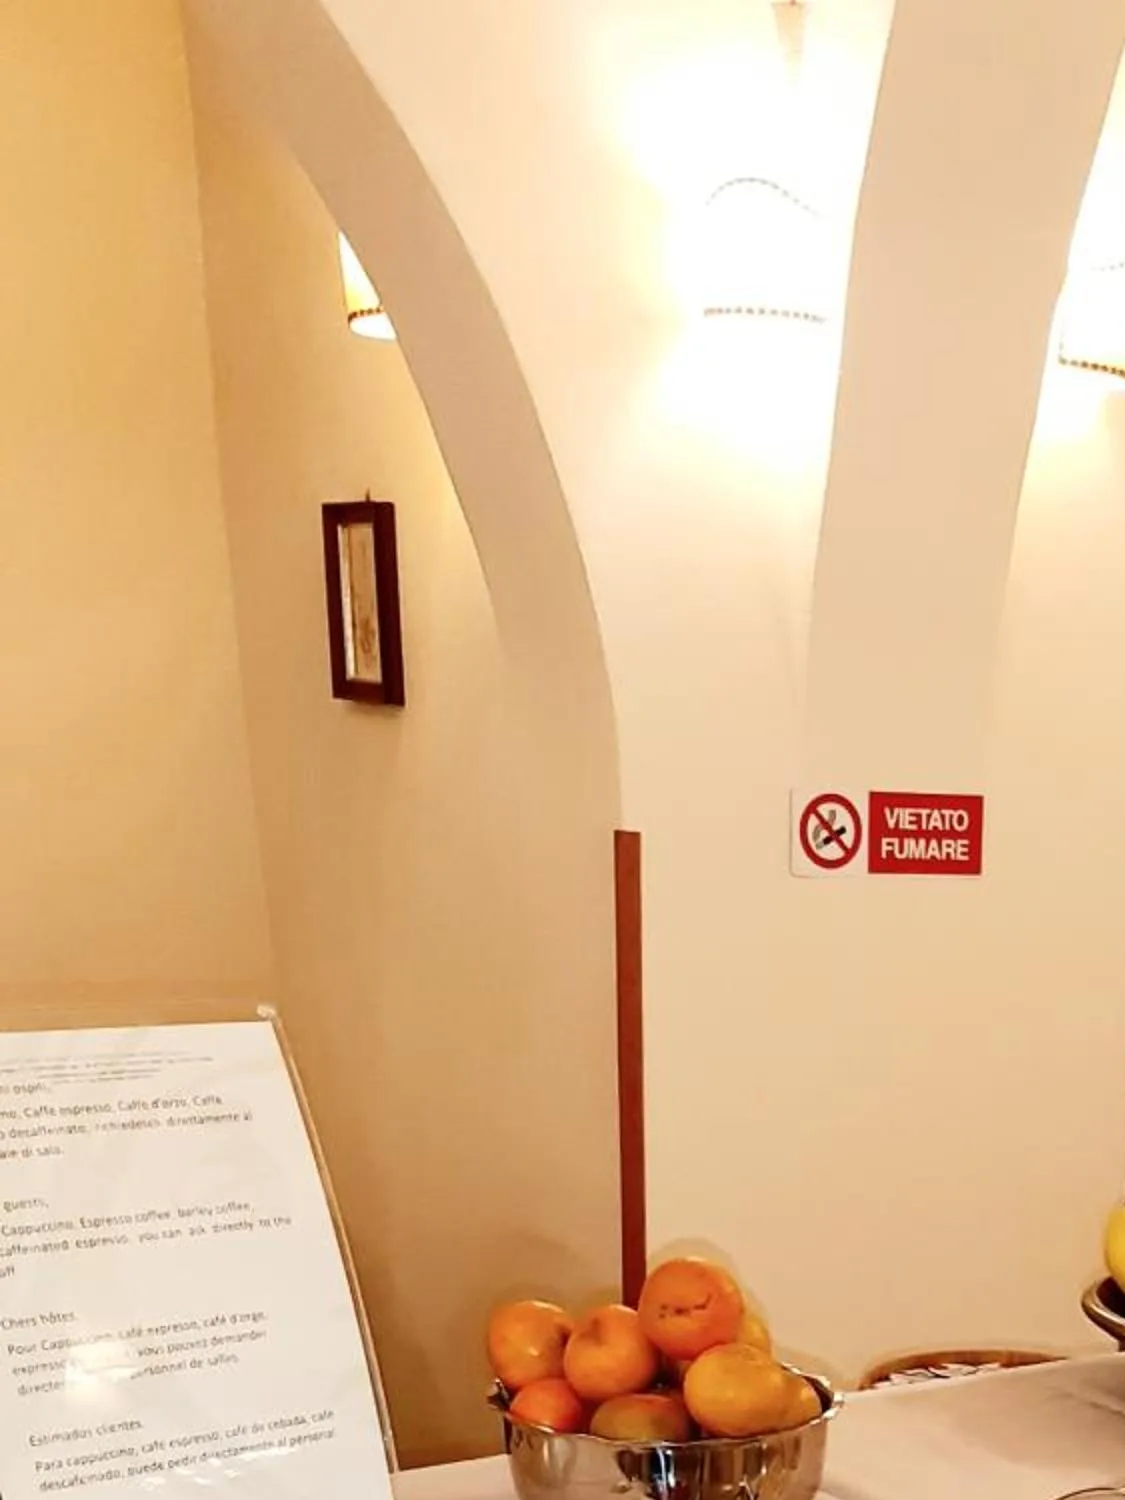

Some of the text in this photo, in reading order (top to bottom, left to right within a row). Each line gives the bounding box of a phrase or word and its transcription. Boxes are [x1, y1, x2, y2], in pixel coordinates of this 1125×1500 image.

[883, 806, 969, 831] VIETATO
[881, 837, 970, 861] FUMARE
[7, 1342, 37, 1356] Pour
[28, 1427, 93, 1448] Estimados
[34, 1459, 64, 1473] Para
[127, 1460, 165, 1478] puede
